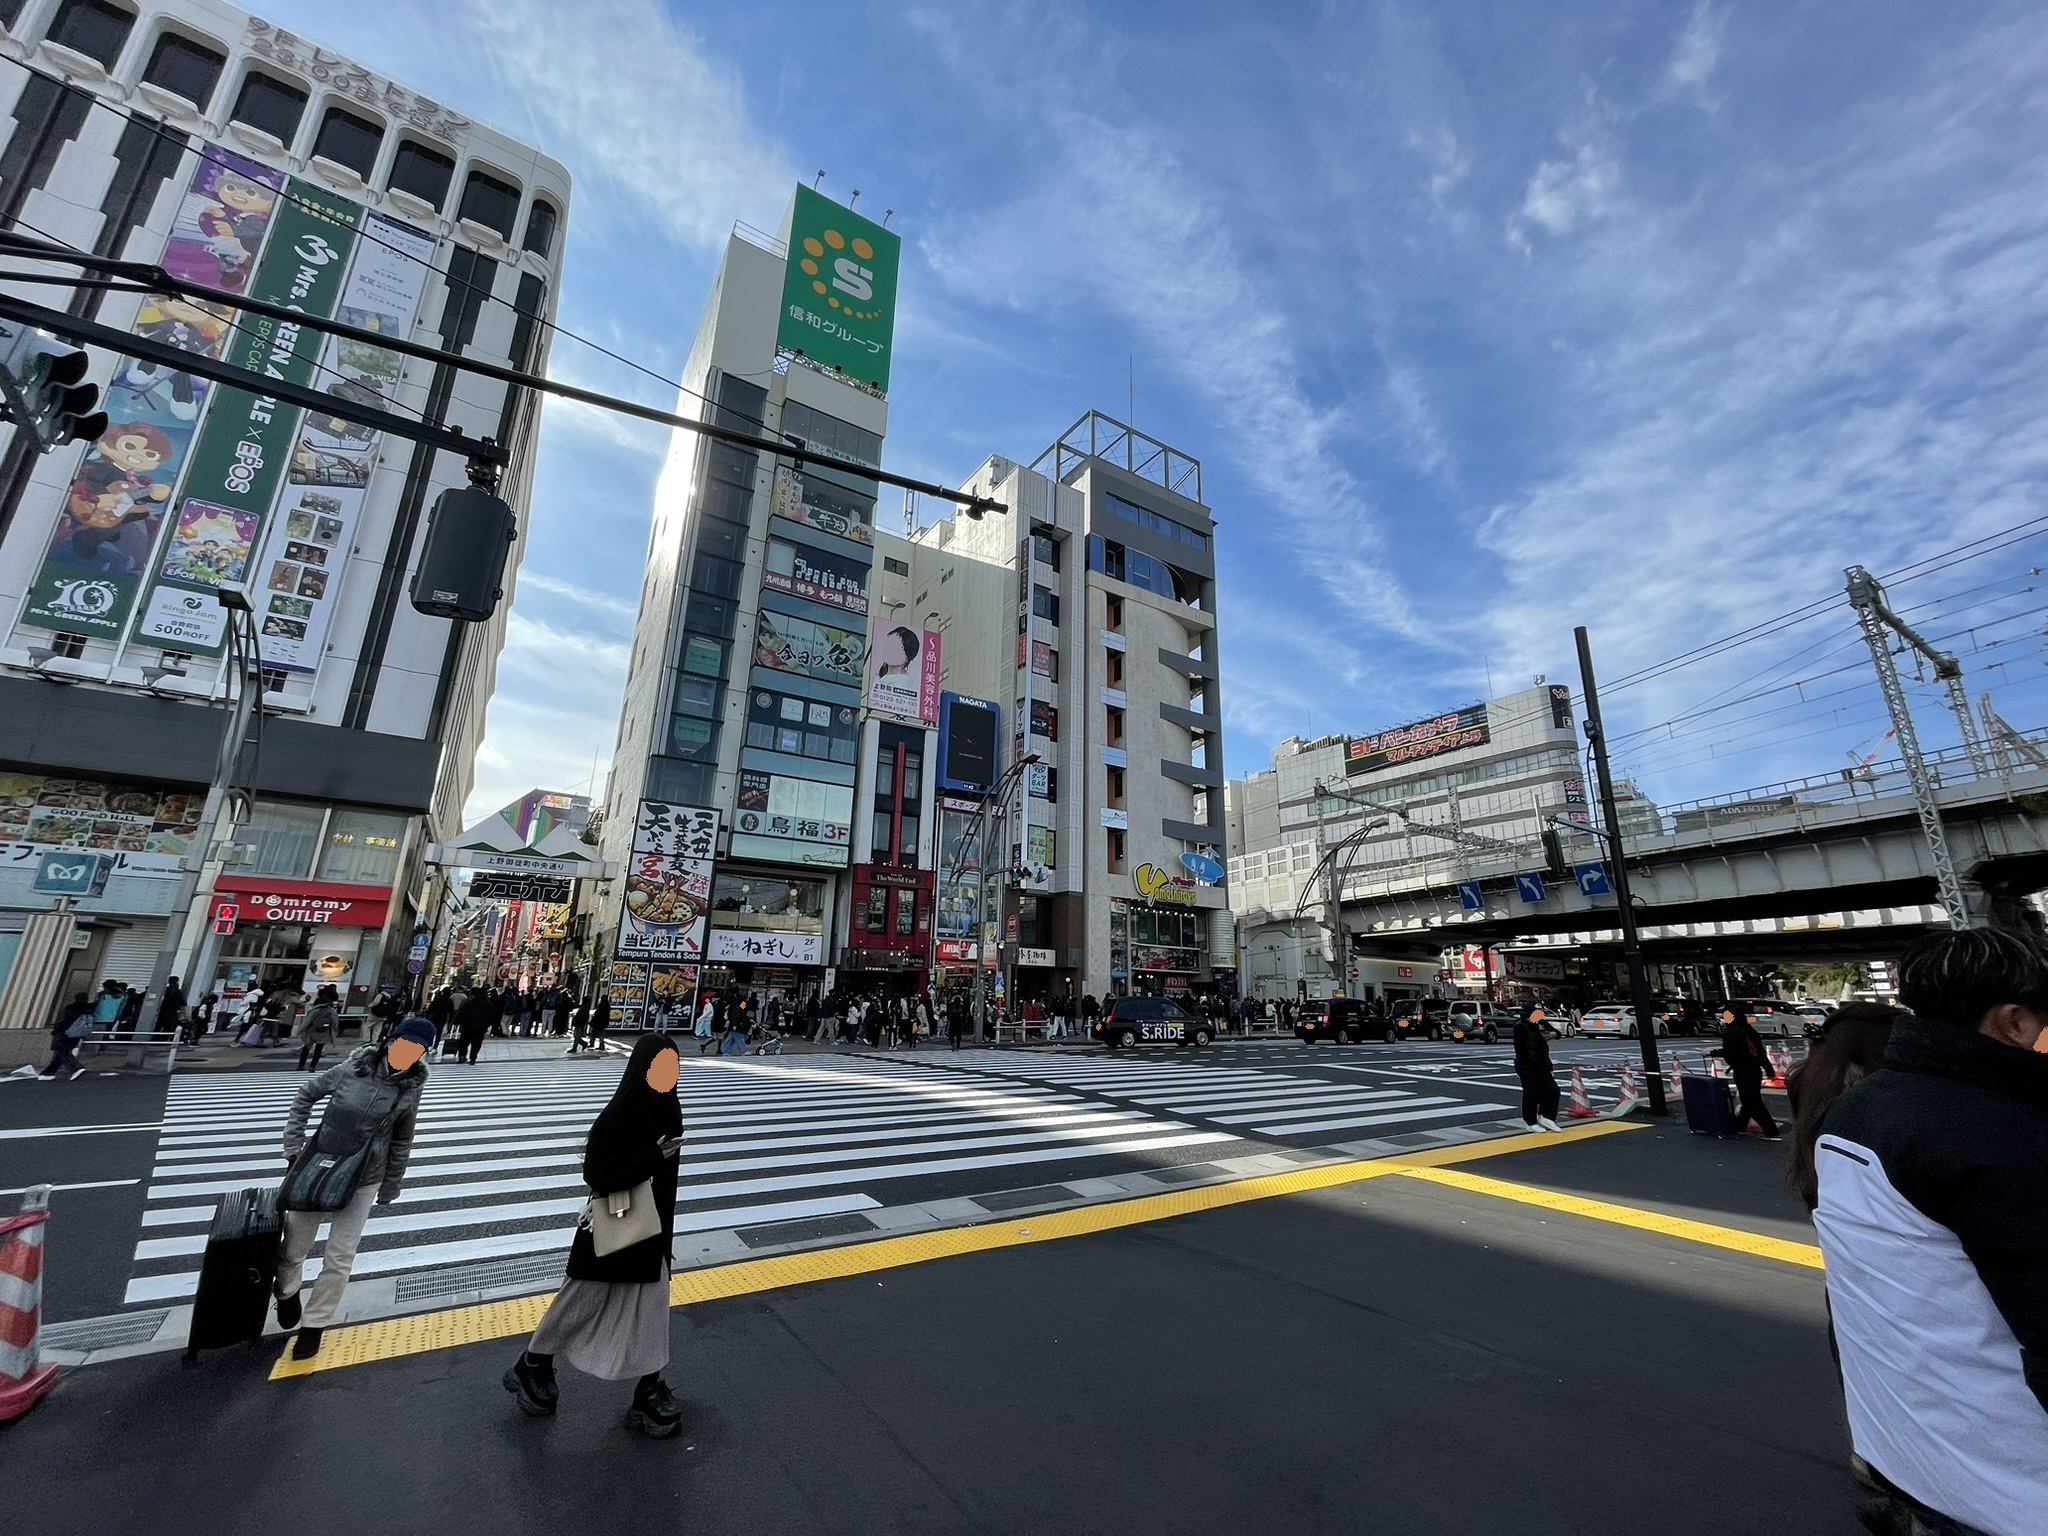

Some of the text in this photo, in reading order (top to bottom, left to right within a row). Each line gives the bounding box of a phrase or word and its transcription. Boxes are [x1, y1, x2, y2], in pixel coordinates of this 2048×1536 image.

[312, 47, 471, 131] レストラン
[289, 264, 319, 299] Mrs.
[788, 303, 884, 355] 信和グループ
[54, 611, 87, 623] GREEN
[87, 617, 119, 629] APPLE
[161, 603, 218, 620] Ringo Jam
[922, 650, 938, 719] 品川美容外科
[958, 696, 988, 709] NAGATA
[1350, 713, 1459, 758] ヨドバシカメラ
[1031, 779, 1046, 788] BAR
[51, 807, 78, 817] GOO
[1720, 806, 1741, 815] APA
[638, 802, 672, 855] 天ぷら
[767, 816, 849, 840] 鳥福 3F
[486, 856, 565, 872] 上野御徒町中央通り
[266, 907, 333, 924] OUTLET
[742, 936, 795, 959] ねぎし
[804, 938, 816, 946] 2F
[617, 948, 649, 959] Tempura
[650, 950, 675, 960] Tendon
[683, 952, 701, 961] Soba
[803, 953, 814, 962] B1
[1142, 1027, 1185, 1040] S.RIDE
